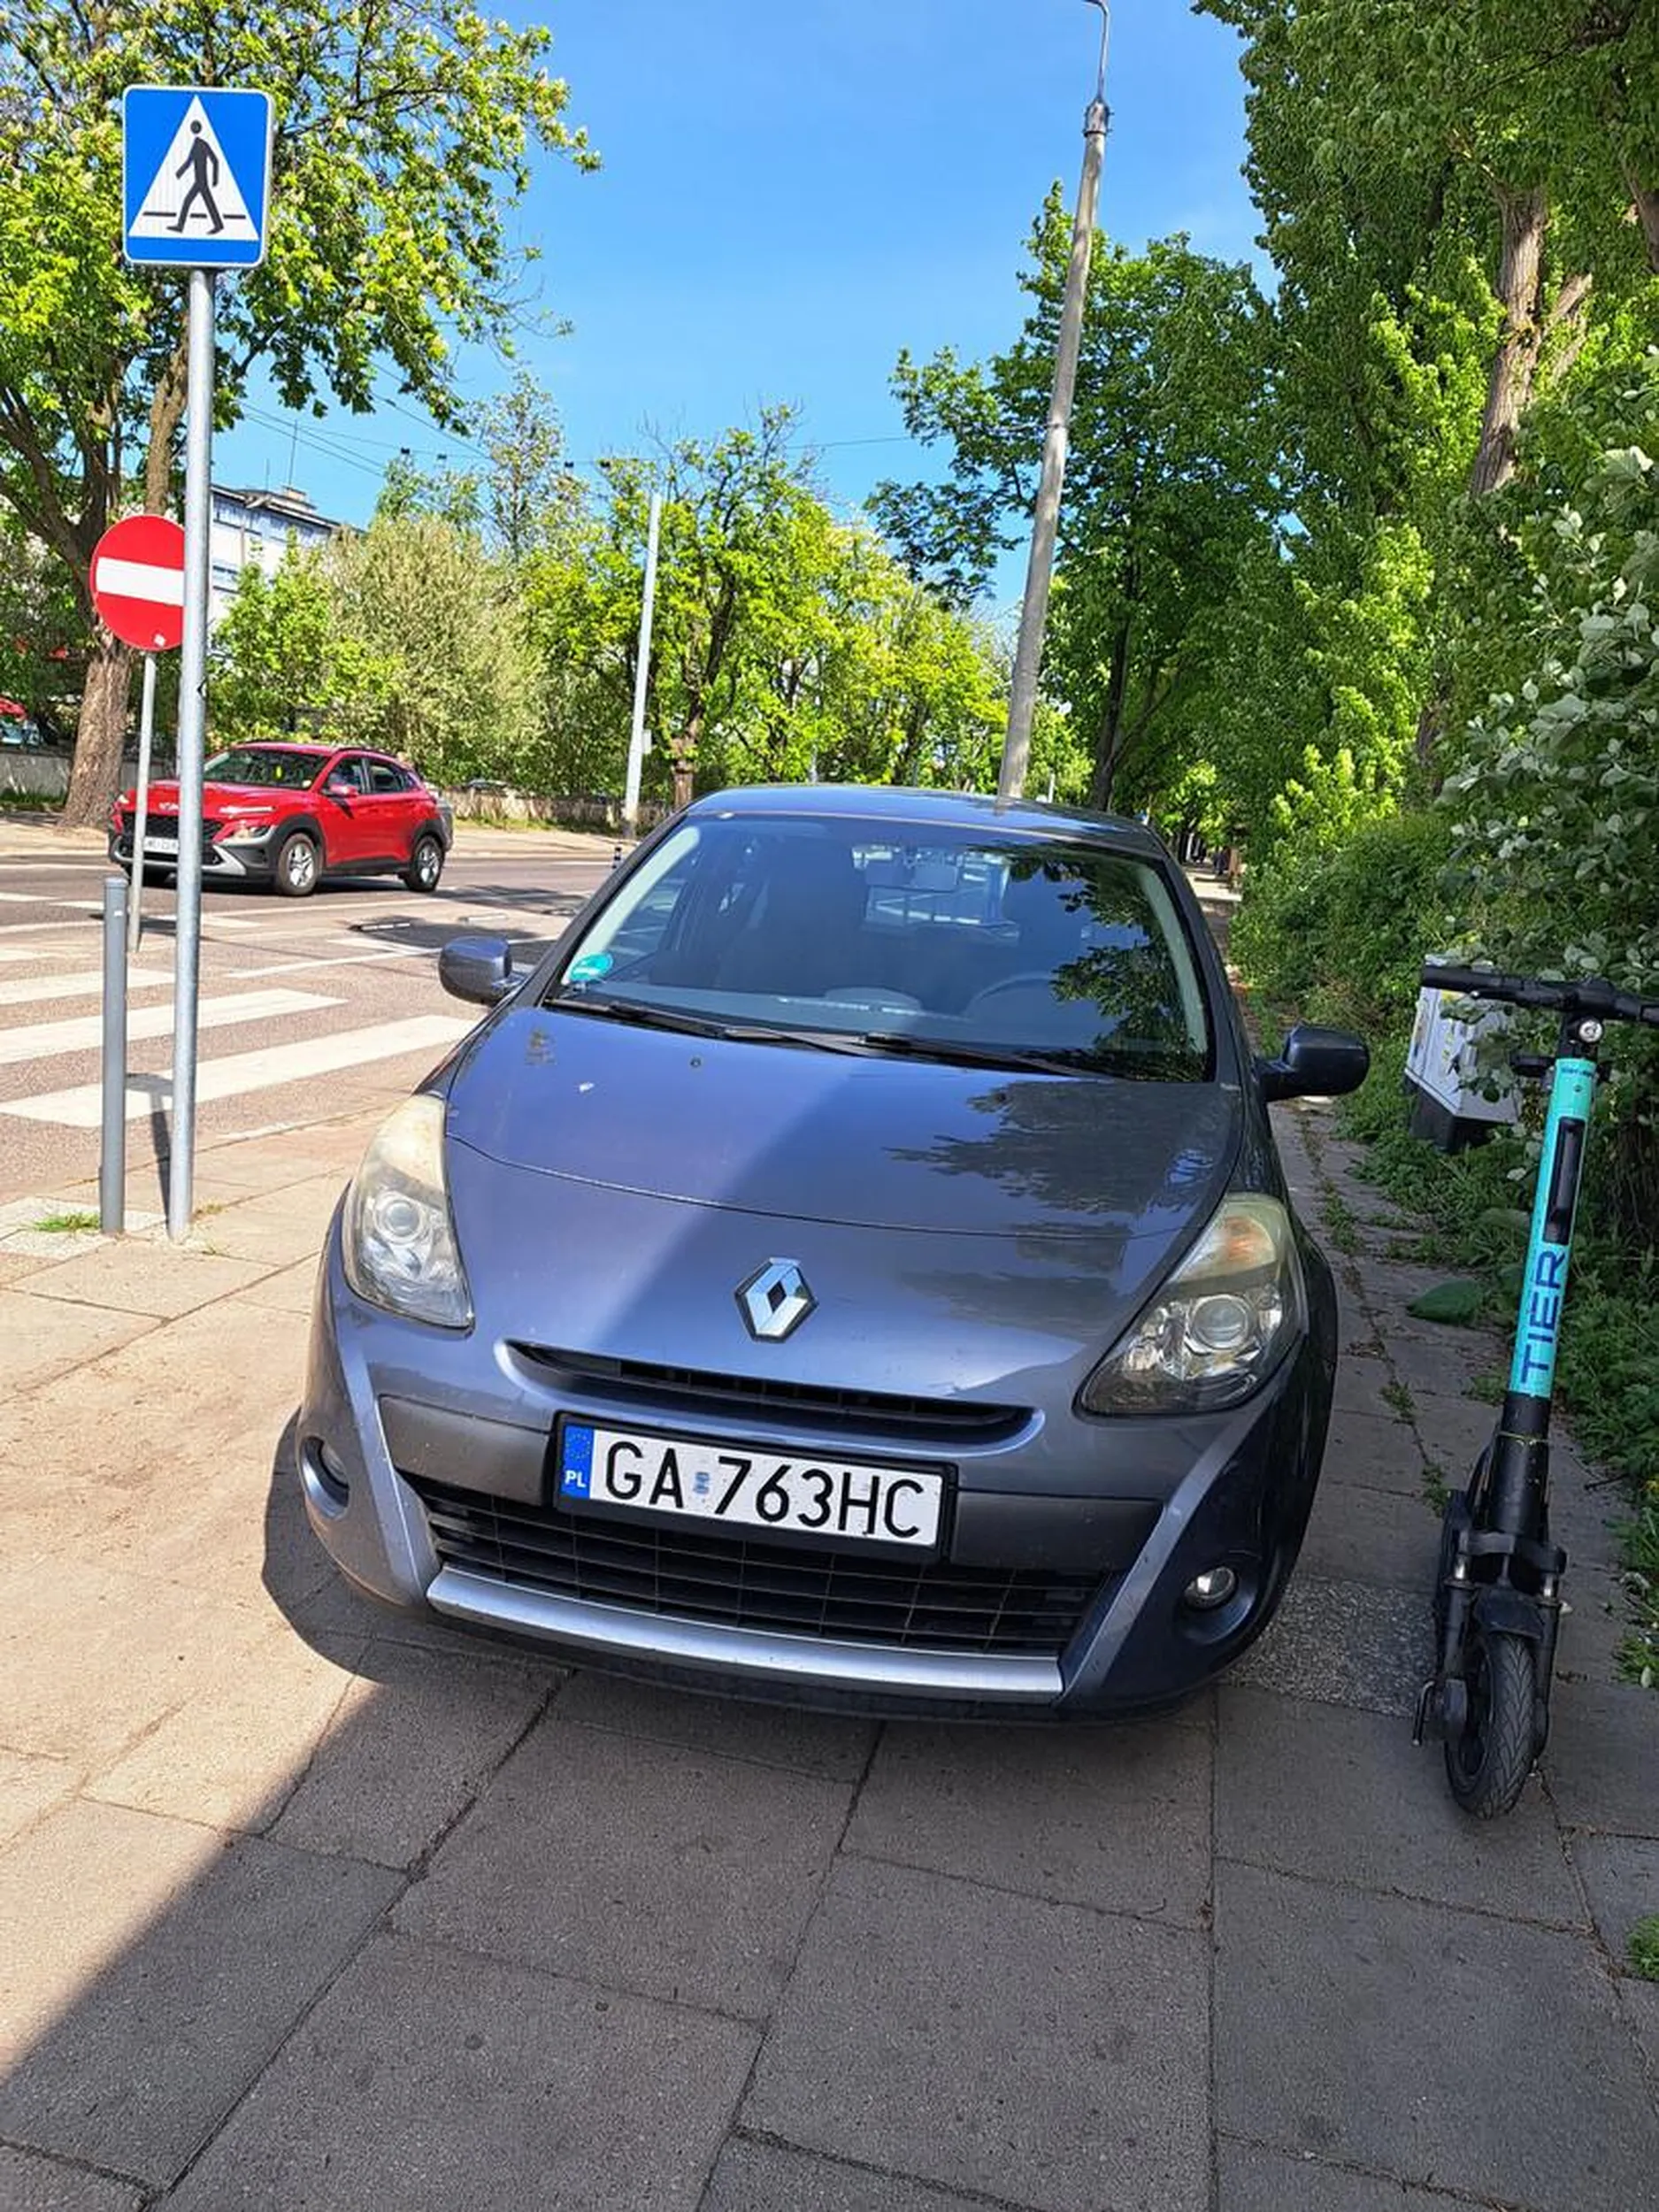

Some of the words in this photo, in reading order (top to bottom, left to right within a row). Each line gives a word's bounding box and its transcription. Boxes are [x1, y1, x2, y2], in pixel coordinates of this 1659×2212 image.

[1520, 1250, 1566, 1384] TIER
[565, 1469, 587, 1488] PL
[605, 1440, 684, 1509] GA
[714, 1455, 924, 1539] 763HC
